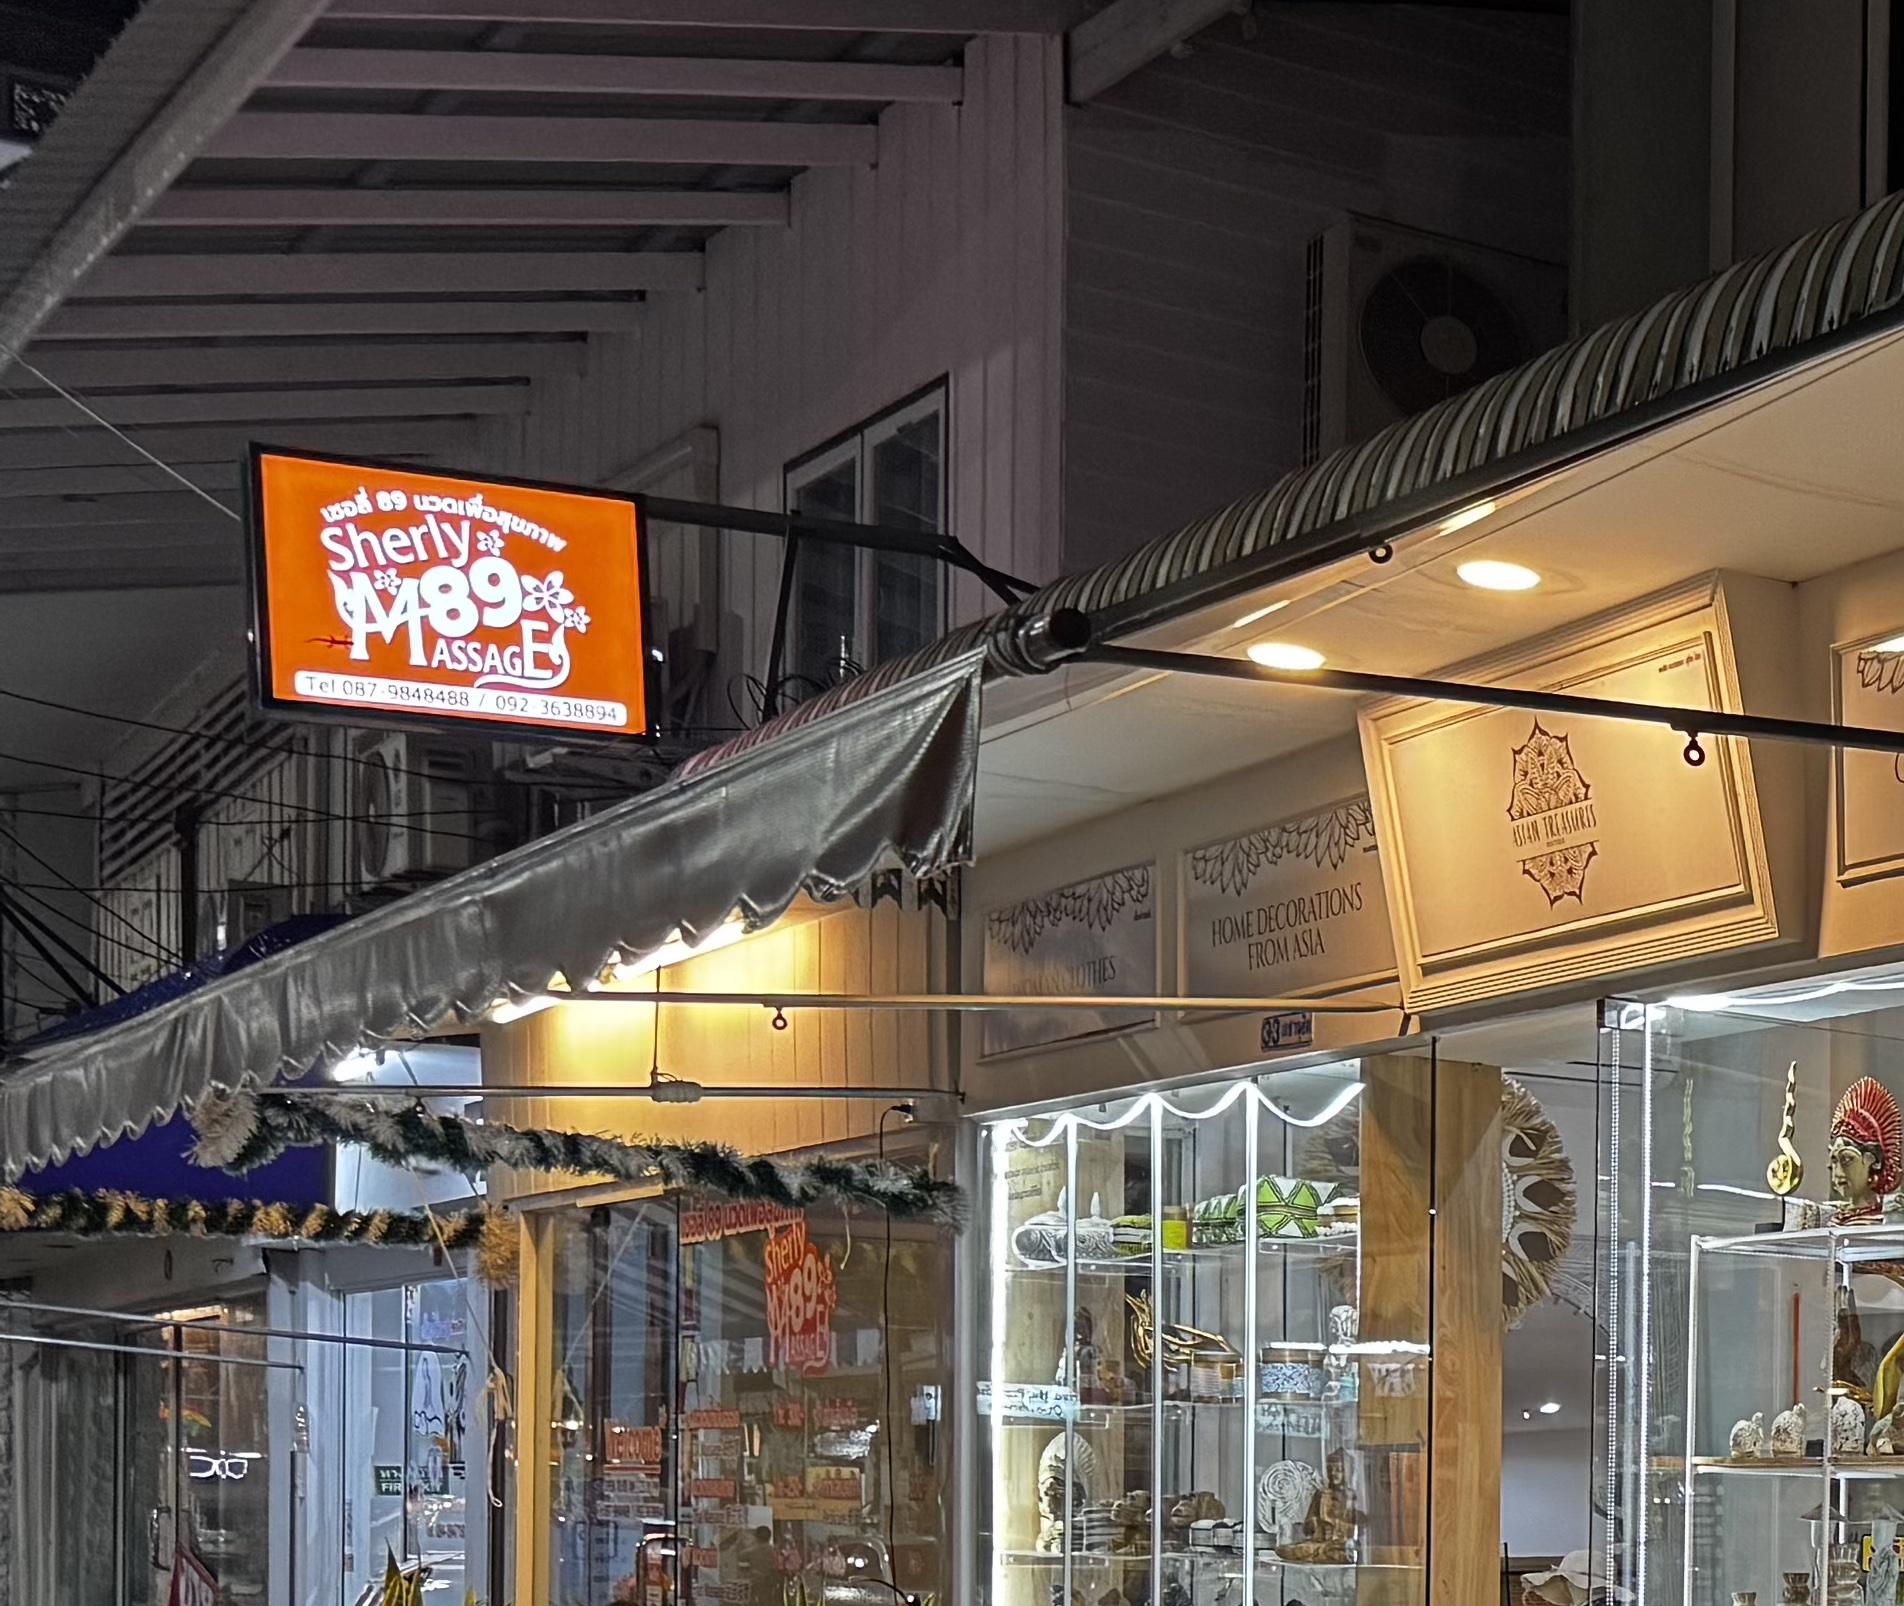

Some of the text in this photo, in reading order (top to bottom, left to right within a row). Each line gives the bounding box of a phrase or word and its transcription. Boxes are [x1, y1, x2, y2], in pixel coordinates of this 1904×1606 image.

[376, 490, 407, 512] 89
[320, 514, 471, 572] Sherly
[419, 556, 523, 638] 89
[305, 675, 335, 693] Tel
[1211, 882, 1363, 948] HOME DECORATIONS
[1247, 930, 1326, 971] FROM ASIA
[789, 1253, 818, 1333] 89
